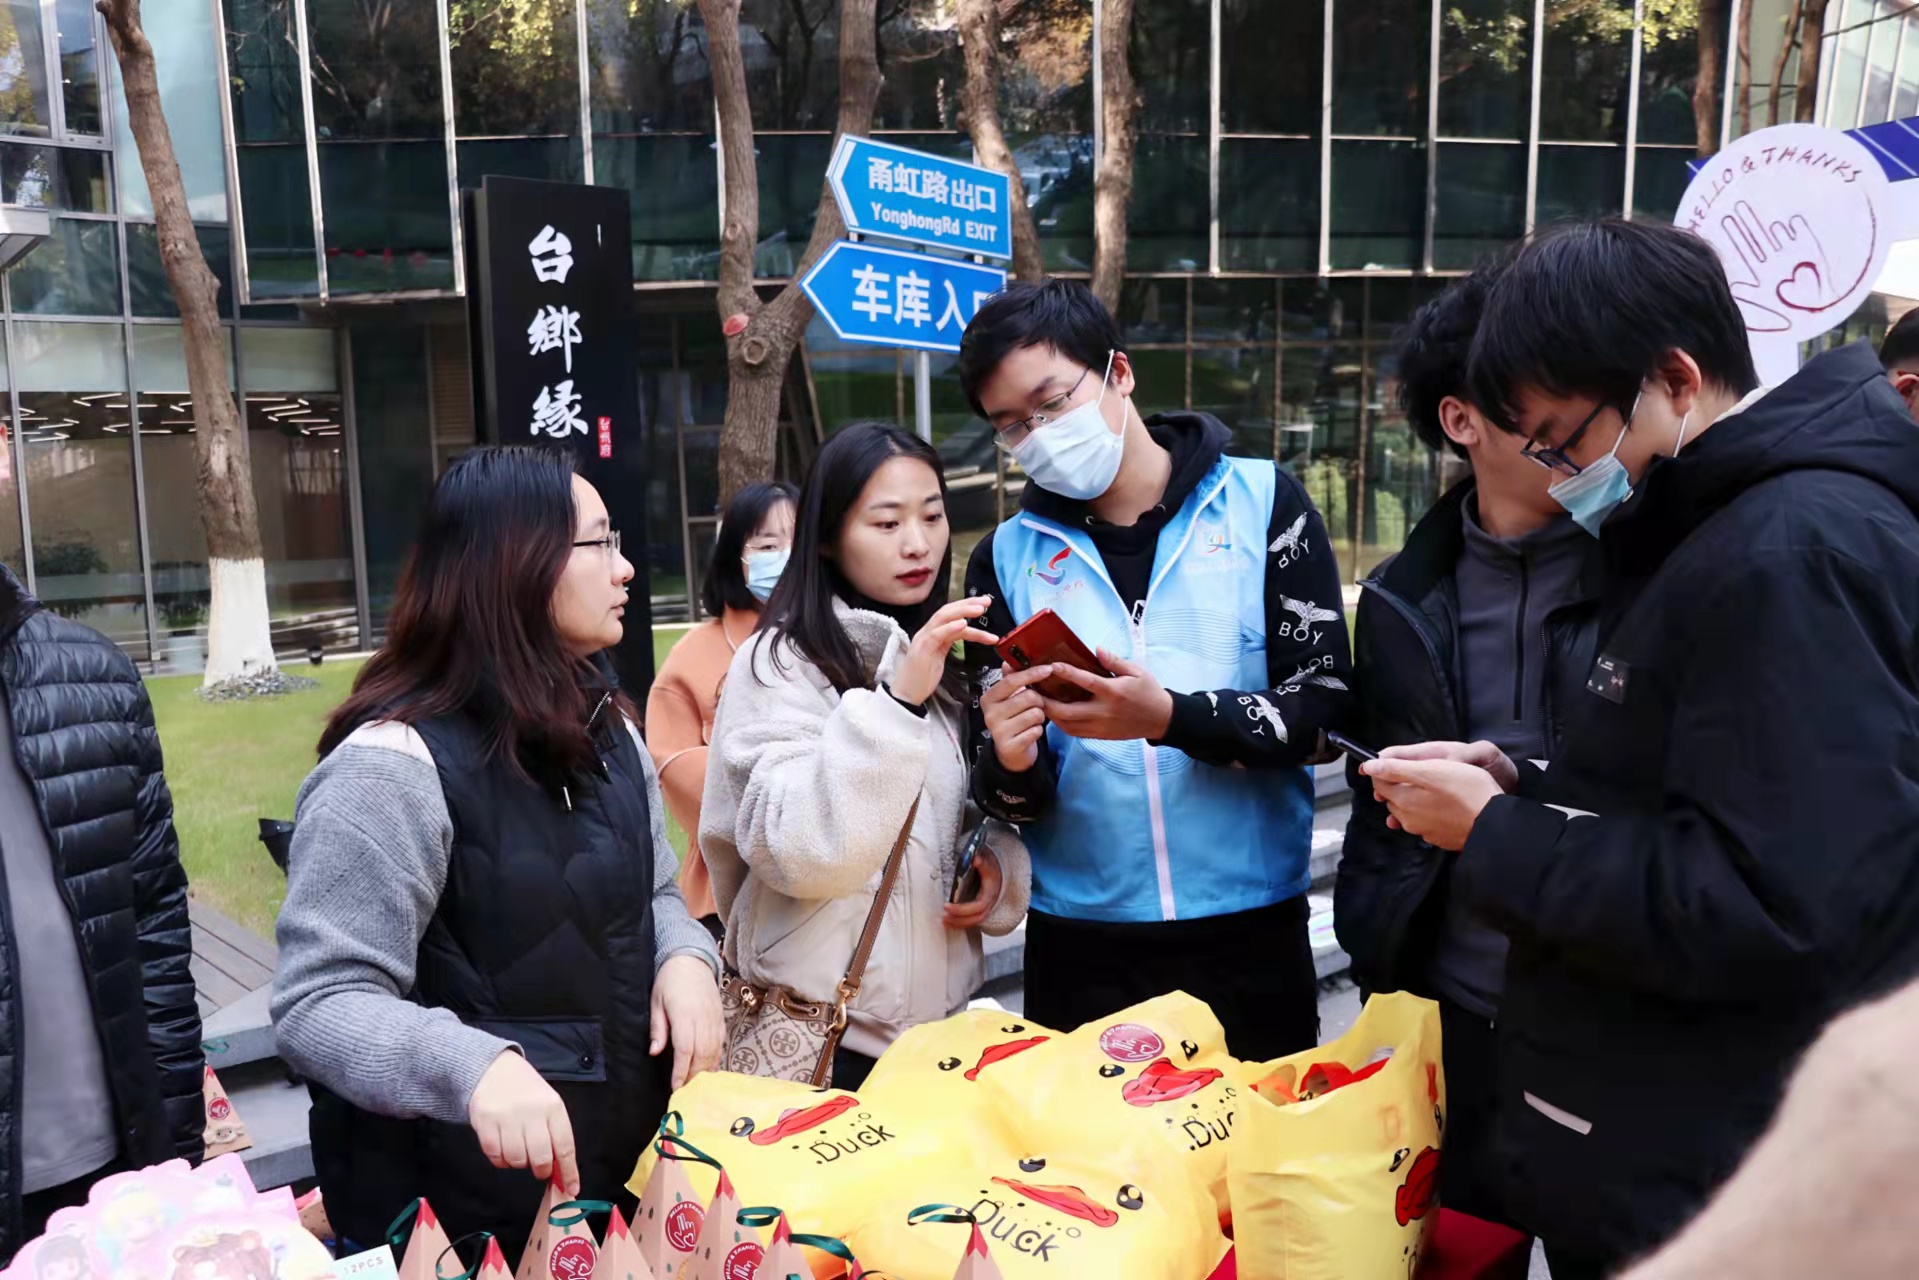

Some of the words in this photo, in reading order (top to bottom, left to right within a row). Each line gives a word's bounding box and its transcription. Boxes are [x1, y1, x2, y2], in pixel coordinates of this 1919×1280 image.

[868, 157, 997, 213] 甬虹路出口
[1686, 167, 1734, 233] HELLO
[1741, 156, 1758, 174] &
[1761, 147, 1862, 184] THANKS
[870, 202, 961, 236] YonghongRd
[965, 221, 998, 242] EXIT
[1278, 538, 1310, 569] BOY
[1278, 621, 1324, 645] BOY
[1237, 696, 1265, 736] BOY
[809, 1125, 896, 1162] Duck
[969, 1199, 1060, 1262] Duck
